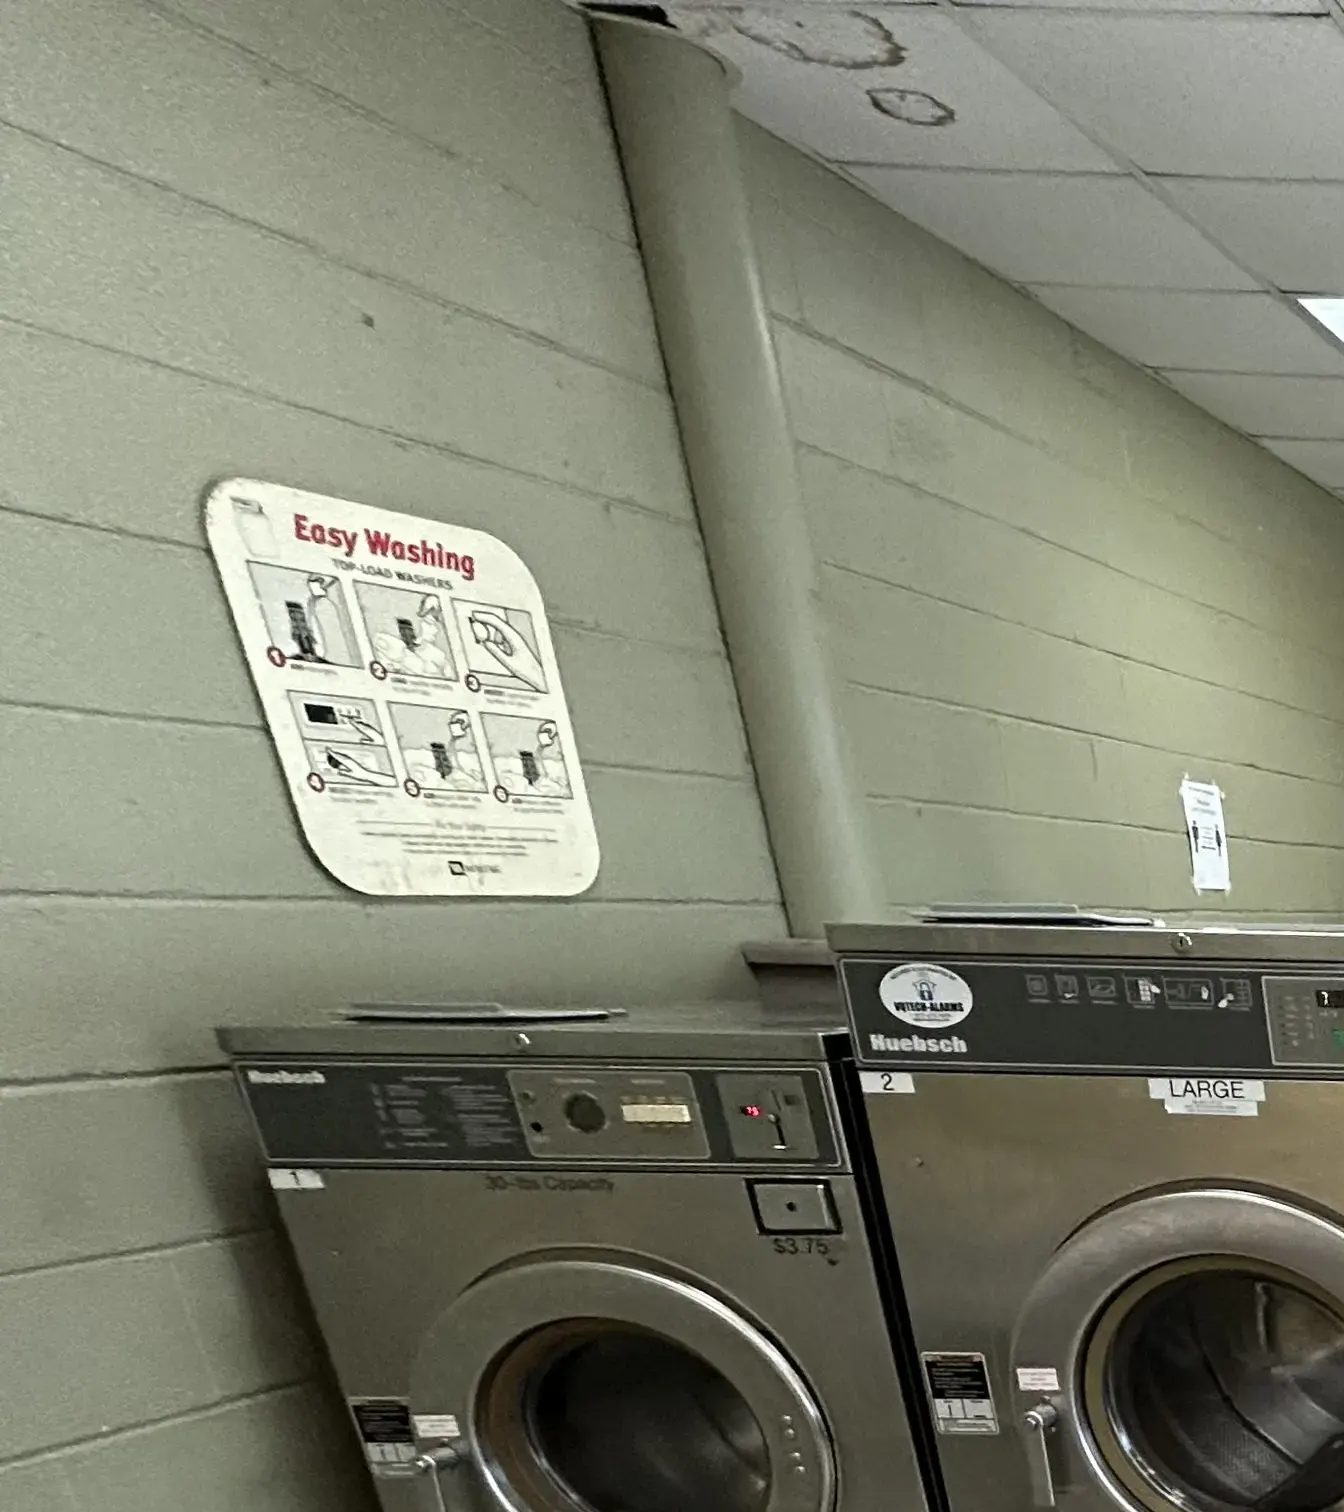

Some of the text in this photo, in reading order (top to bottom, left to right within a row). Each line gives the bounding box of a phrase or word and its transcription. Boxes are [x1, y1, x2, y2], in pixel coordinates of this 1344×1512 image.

[293, 513, 475, 581] Easy Washing
[331, 558, 453, 590] TOP-LOAD WASHERS
[869, 1033, 968, 1054] Huebsch
[880, 1073, 895, 1092] 2
[1169, 1080, 1245, 1099] LARGE
[289, 1171, 302, 1186] 1
[773, 1237, 829, 1255] $3.75
